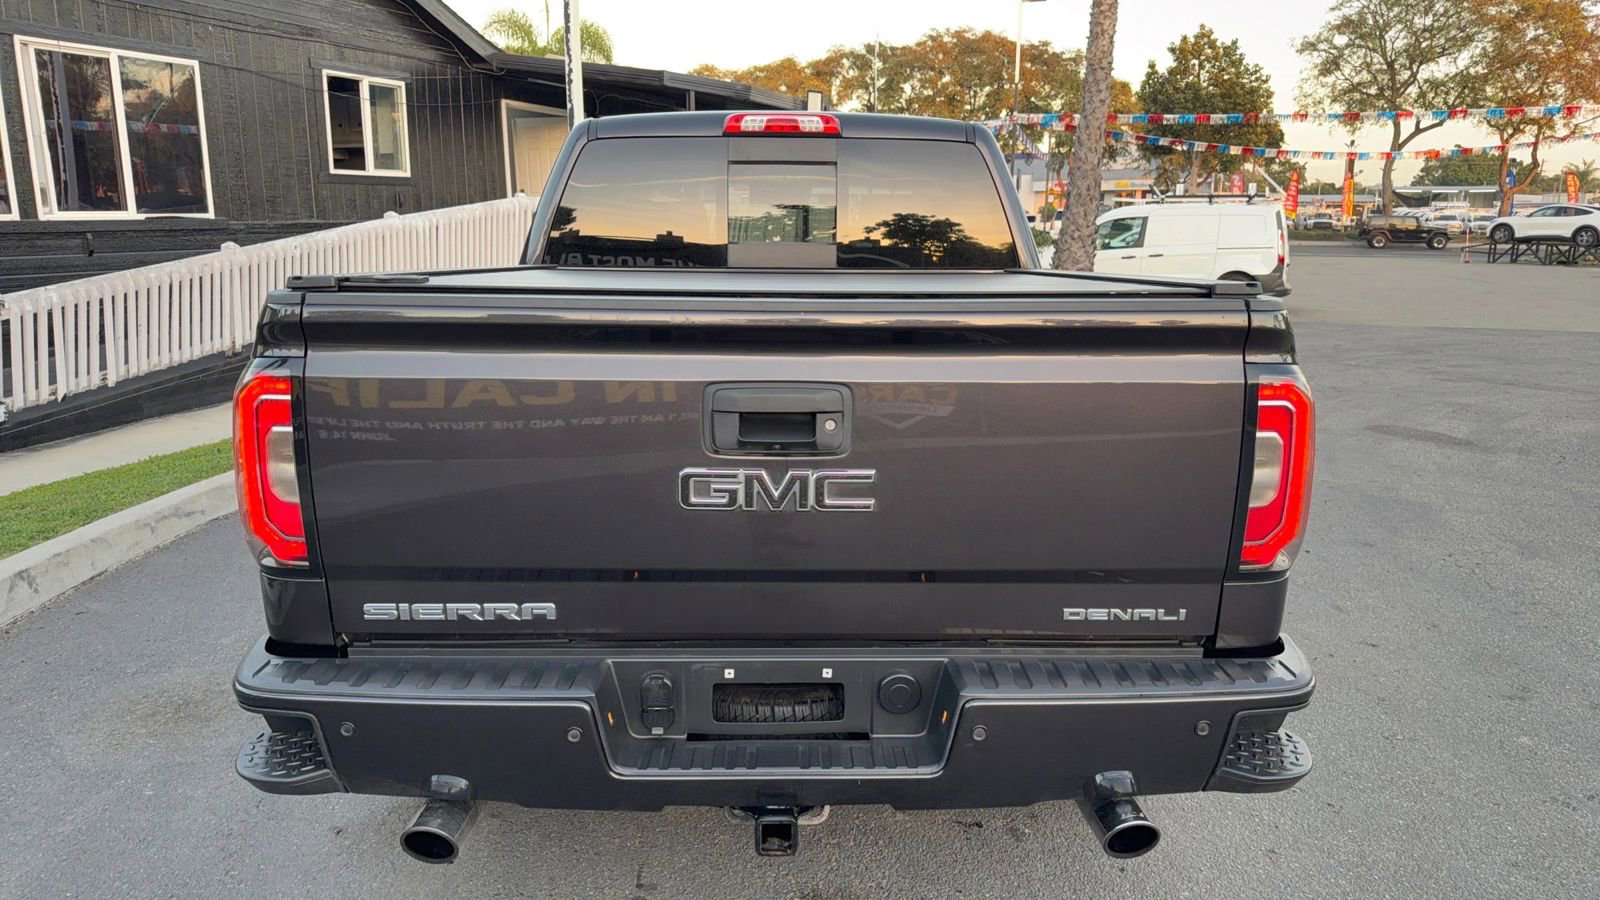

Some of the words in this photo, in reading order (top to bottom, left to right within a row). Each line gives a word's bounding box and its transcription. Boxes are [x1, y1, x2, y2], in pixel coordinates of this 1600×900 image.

[679, 467, 877, 512] GMC
[362, 602, 557, 621] SIERRA
[1062, 607, 1188, 622] DENALI
